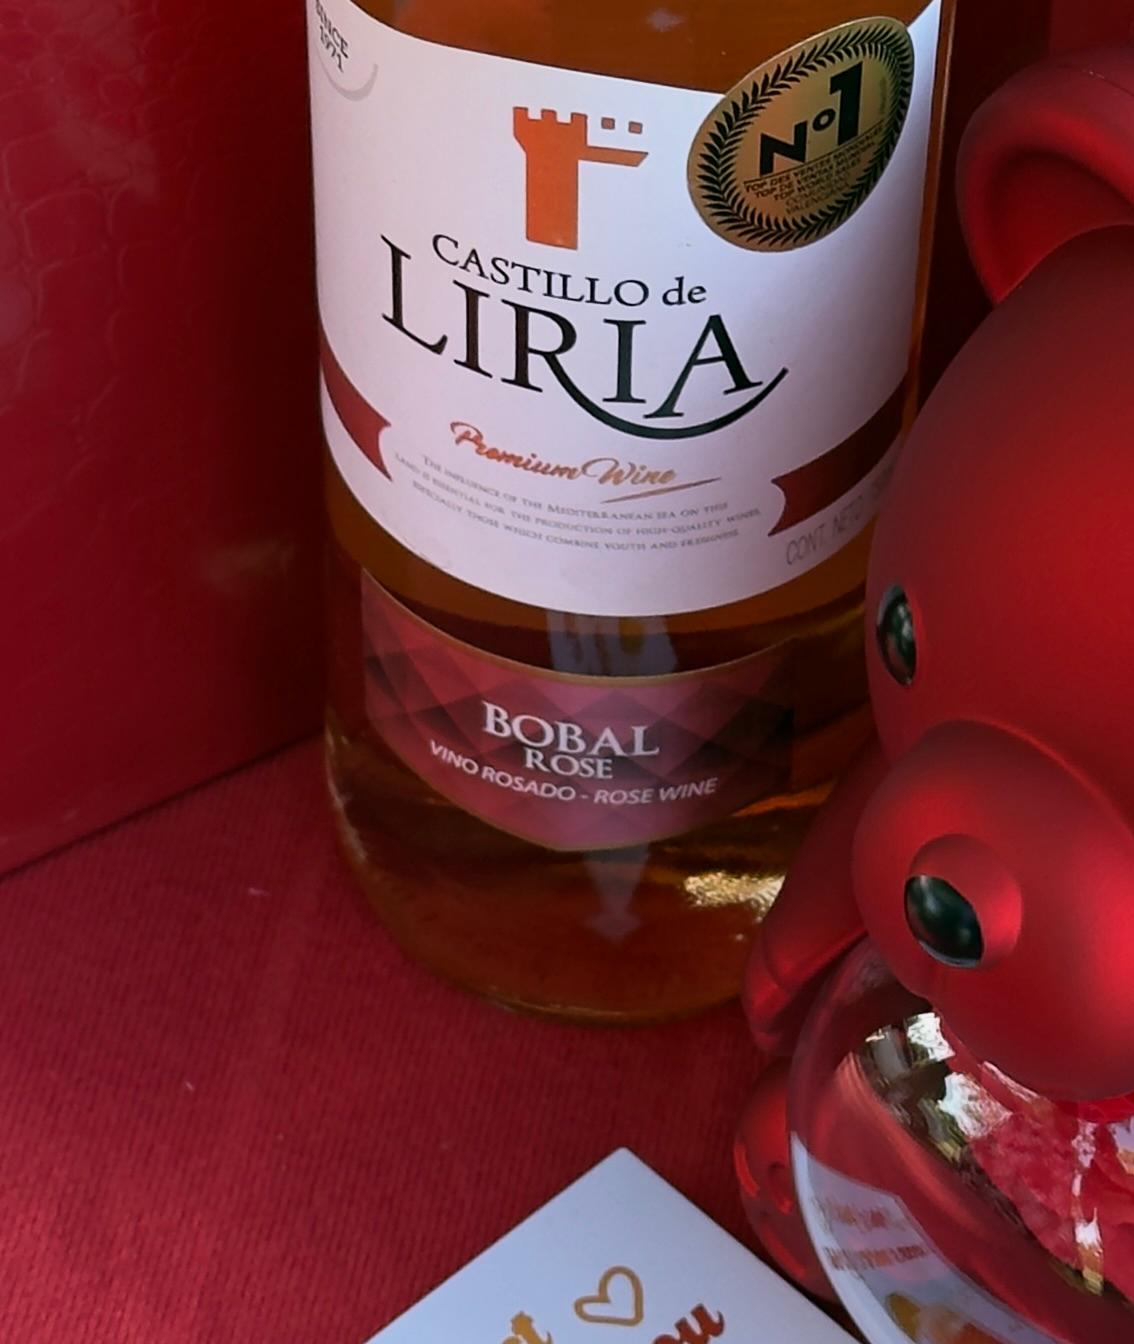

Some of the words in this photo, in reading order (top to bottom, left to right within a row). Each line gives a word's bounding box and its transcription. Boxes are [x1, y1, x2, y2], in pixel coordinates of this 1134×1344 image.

[432, 233, 650, 307] CASTILLO
[662, 276, 707, 306] de
[380, 233, 788, 440] LIRIA
[450, 422, 581, 480] Premium
[582, 457, 677, 486] Wine
[503, 492, 517, 503] OF
[680, 509, 699, 517] ON
[617, 526, 631, 535] OF
[482, 700, 660, 757] BOBAL
[429, 740, 479, 775] VINO
[480, 766, 577, 802] ROSADO
[593, 788, 652, 805] ROSE
[658, 777, 719, 803] WINE
[524, 746, 613, 779] ROSE
